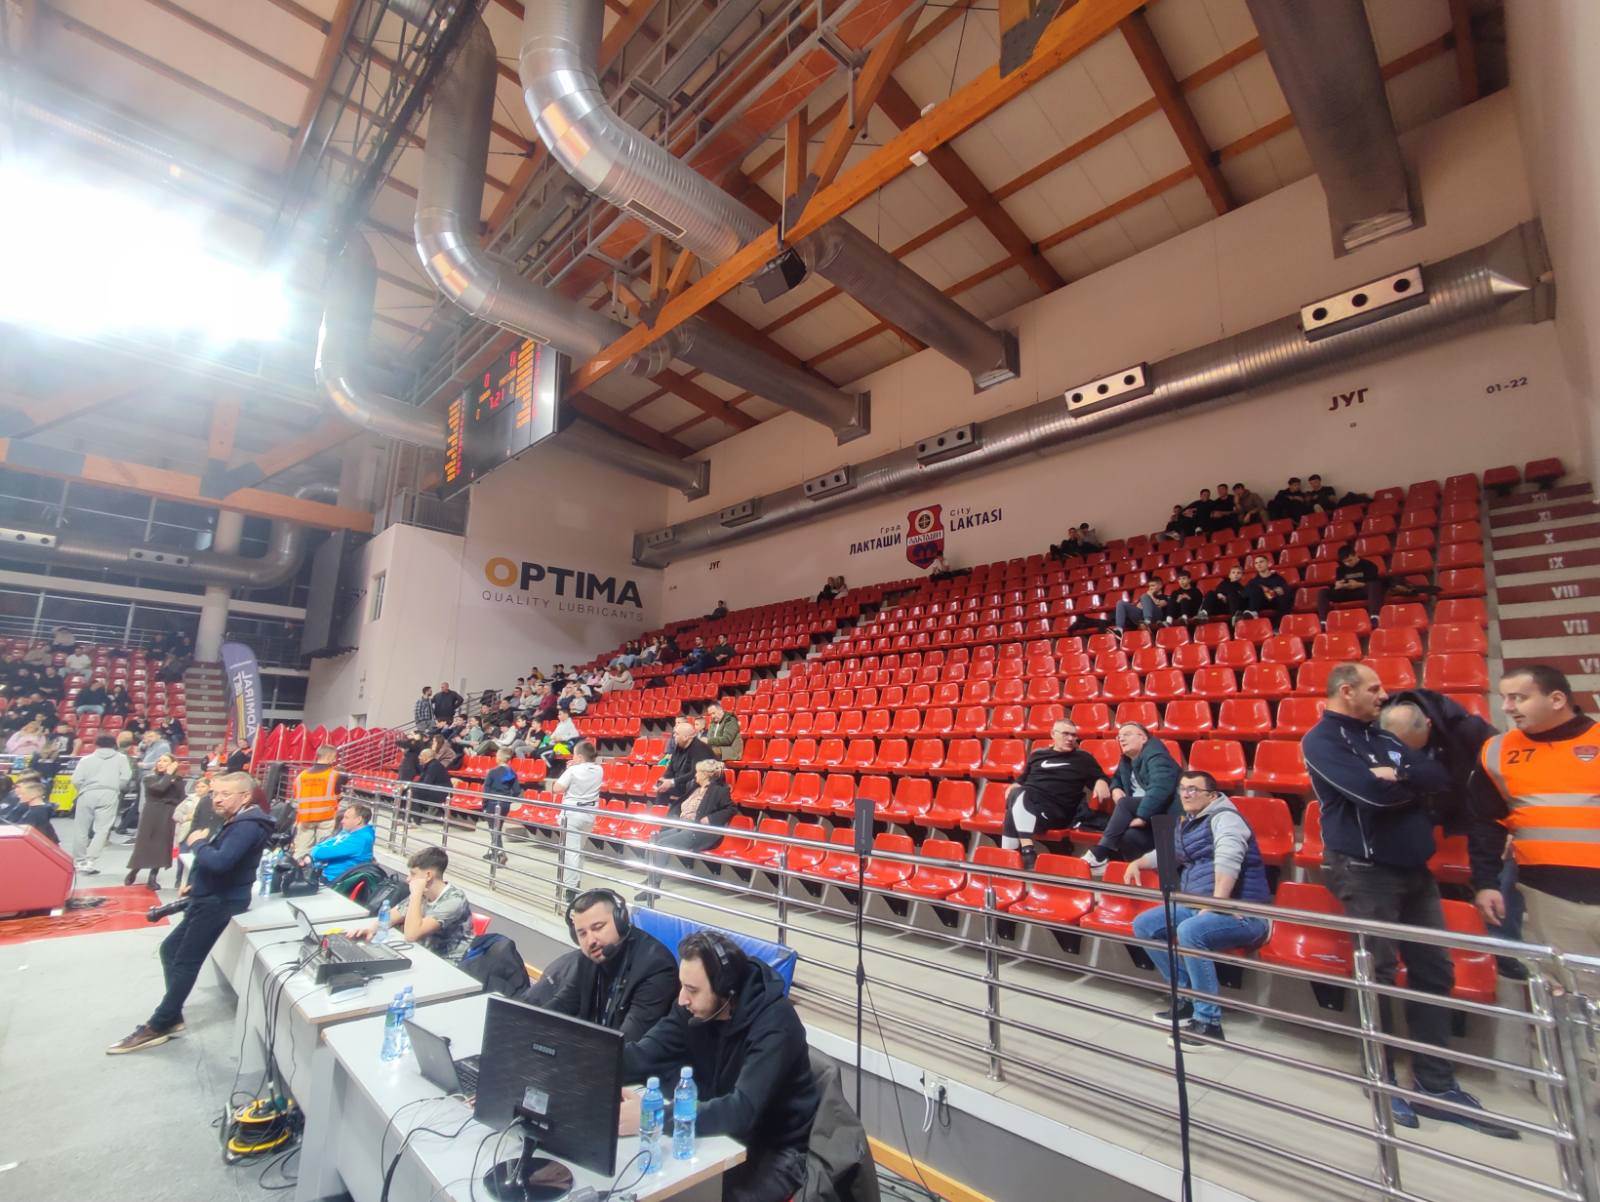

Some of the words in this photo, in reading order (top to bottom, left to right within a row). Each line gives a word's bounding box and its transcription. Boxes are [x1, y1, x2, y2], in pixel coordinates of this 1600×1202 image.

[1486, 376, 1528, 394] 01-22
[950, 506, 971, 517] City
[1538, 511, 1551, 521] XI
[950, 508, 1002, 532] LAKTASI
[880, 525, 901, 534] Град
[849, 532, 901, 555] ЛАКТАШИ
[1544, 533, 1554, 544] X
[1548, 557, 1564, 569] IX
[485, 557, 643, 608] OPTIMA
[1551, 585, 1580, 598] VIII
[482, 590, 549, 608] QUALITY
[559, 601, 643, 622] LUBRICANTS
[1562, 619, 1589, 634] VII
[1507, 748, 1536, 764] 27
